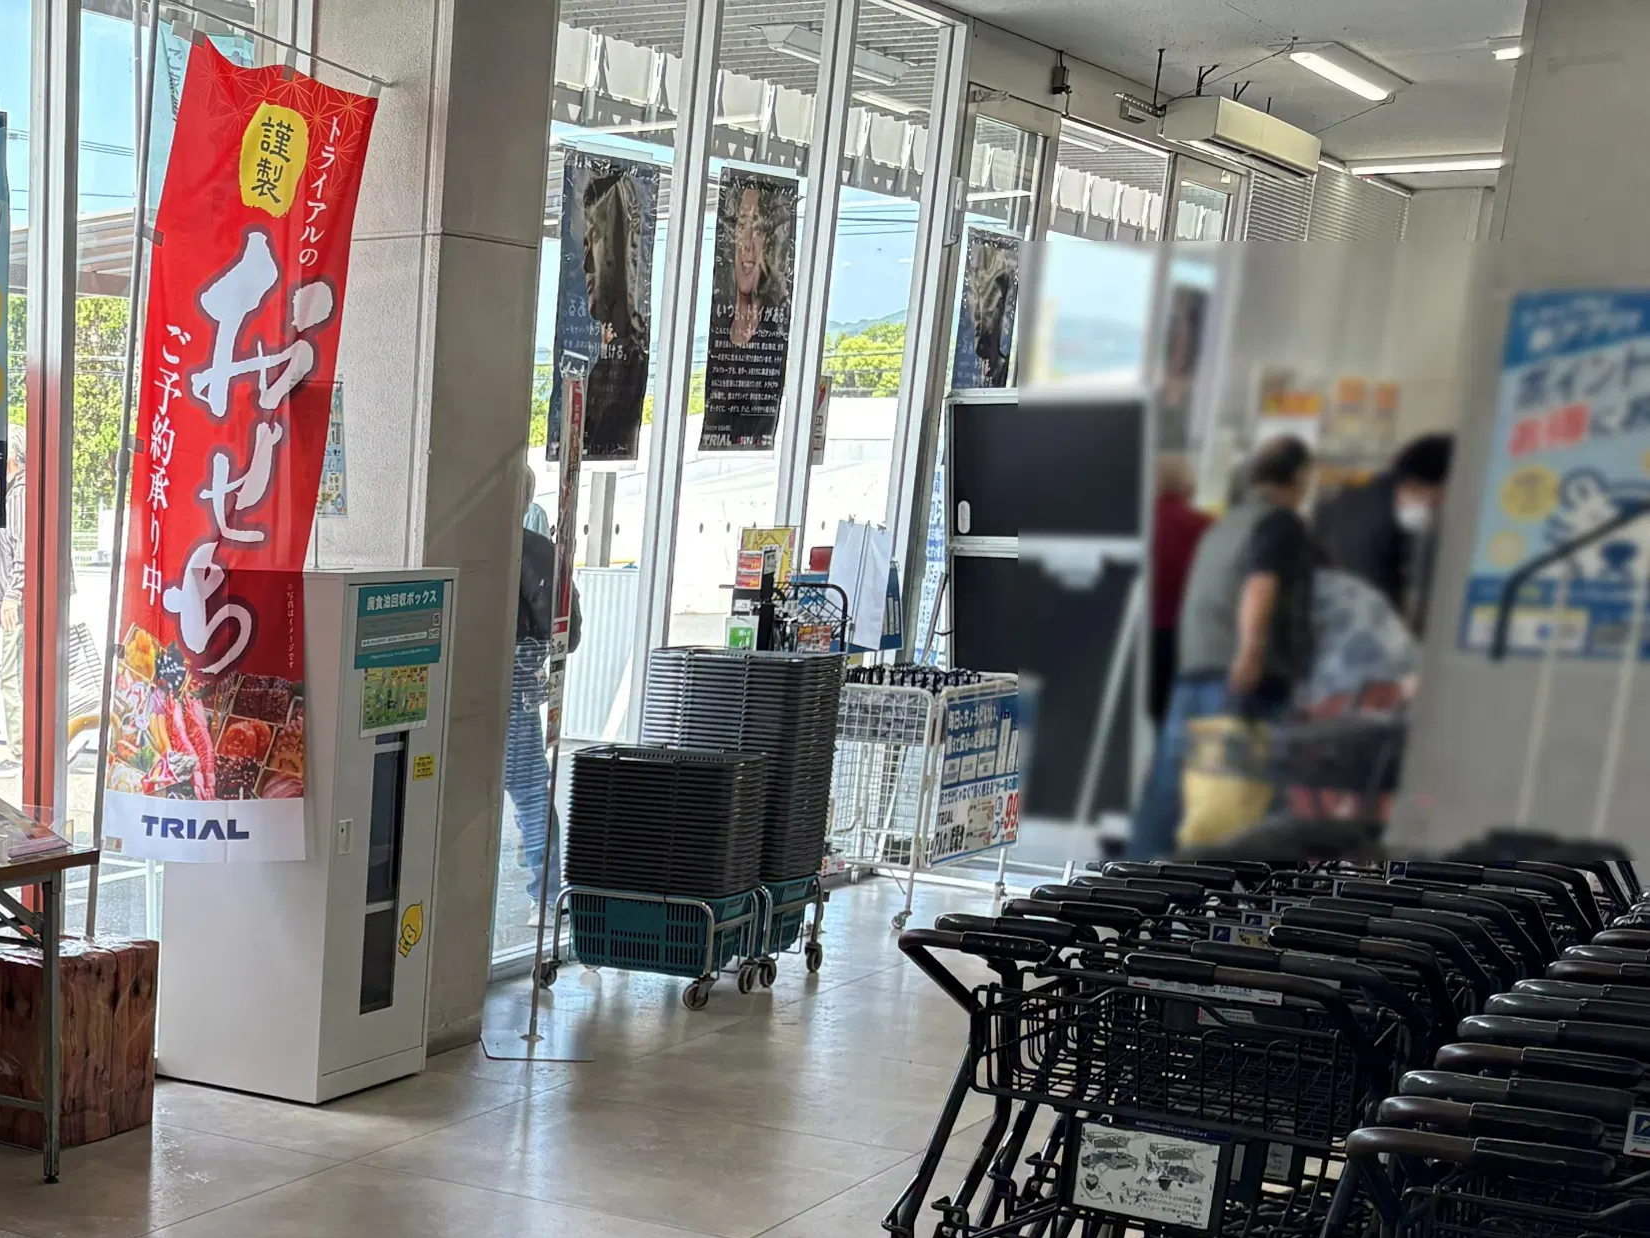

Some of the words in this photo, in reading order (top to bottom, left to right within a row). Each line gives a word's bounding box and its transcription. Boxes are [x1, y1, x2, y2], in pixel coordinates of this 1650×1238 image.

[251, 116, 295, 204] 謹製
[299, 116, 341, 267] トライアルの
[141, 323, 192, 606] ご予約承り中
[162, 231, 333, 674] おせち
[140, 814, 250, 841] TRIAL
